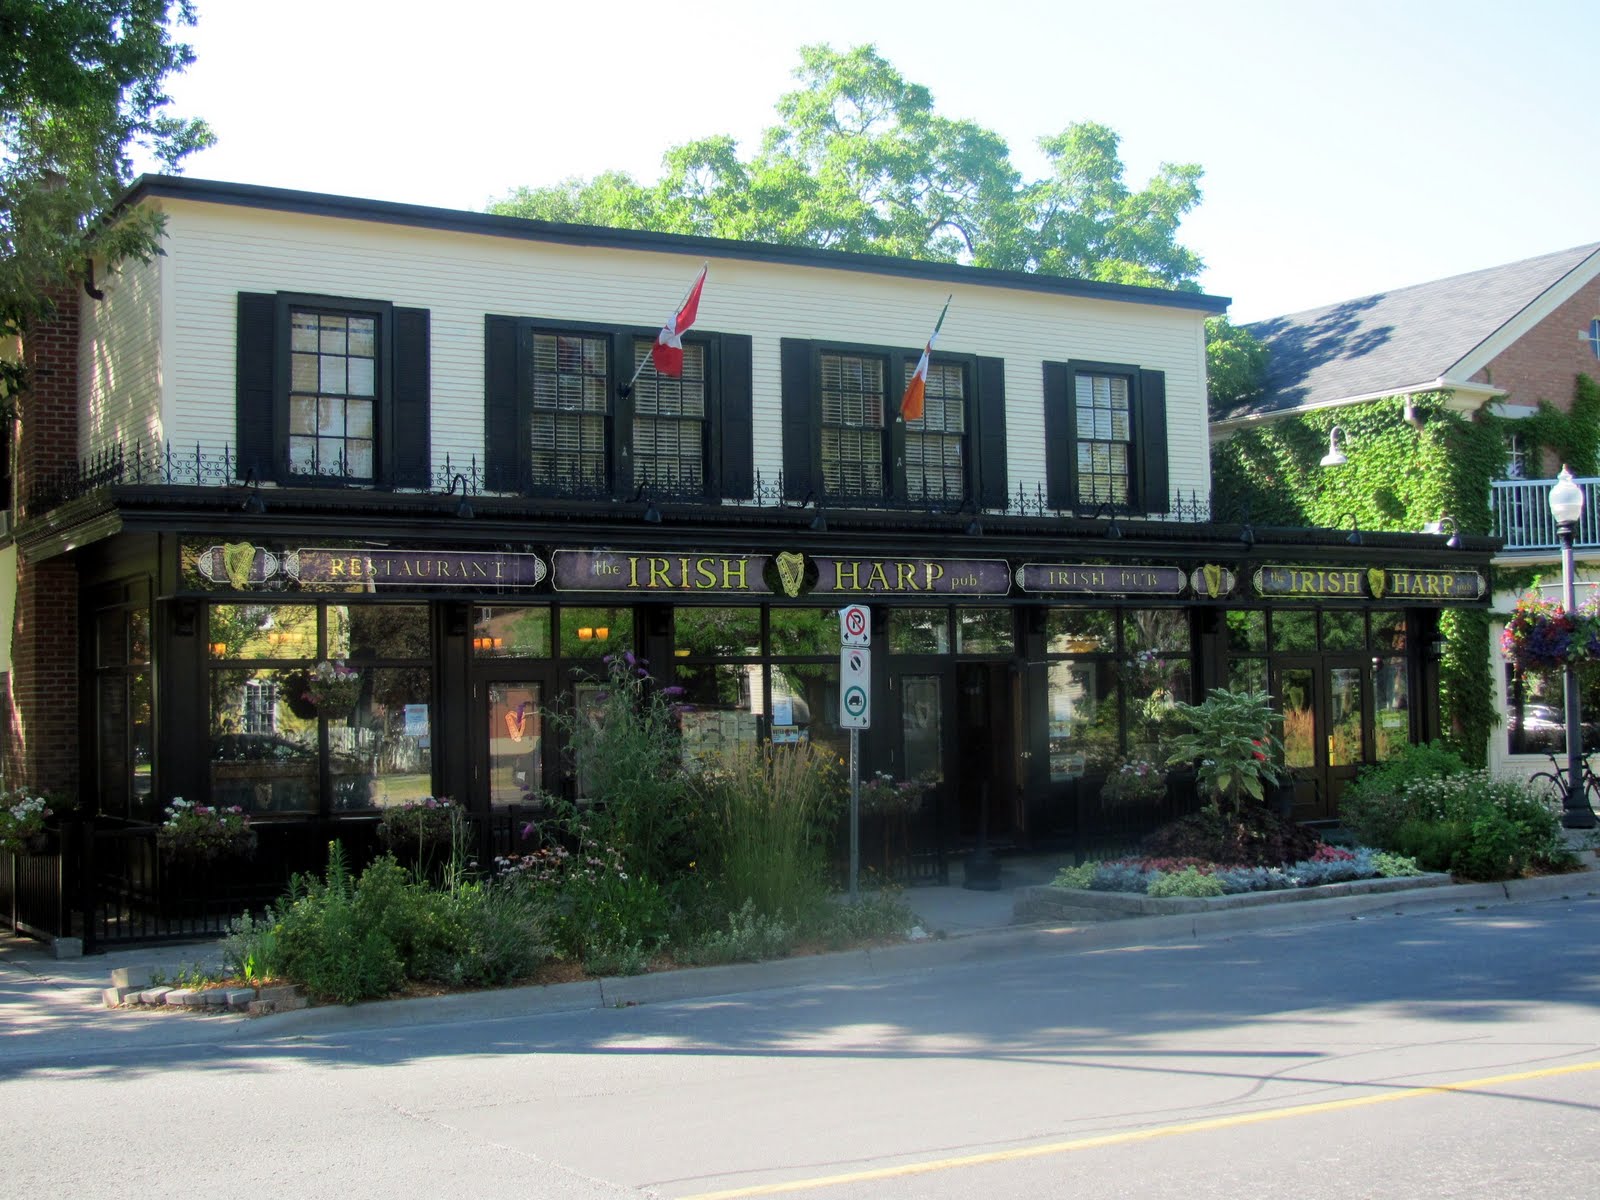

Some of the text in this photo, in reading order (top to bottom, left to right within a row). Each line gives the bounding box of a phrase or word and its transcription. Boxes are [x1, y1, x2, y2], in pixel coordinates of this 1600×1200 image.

[330, 558, 506, 578] RESTAURANT
[594, 556, 977, 591] the IRISH HARP pub
[1049, 571, 1157, 586] IRISH PUB
[1289, 571, 1360, 593] IRISH
[1392, 573, 1454, 595] HARP
